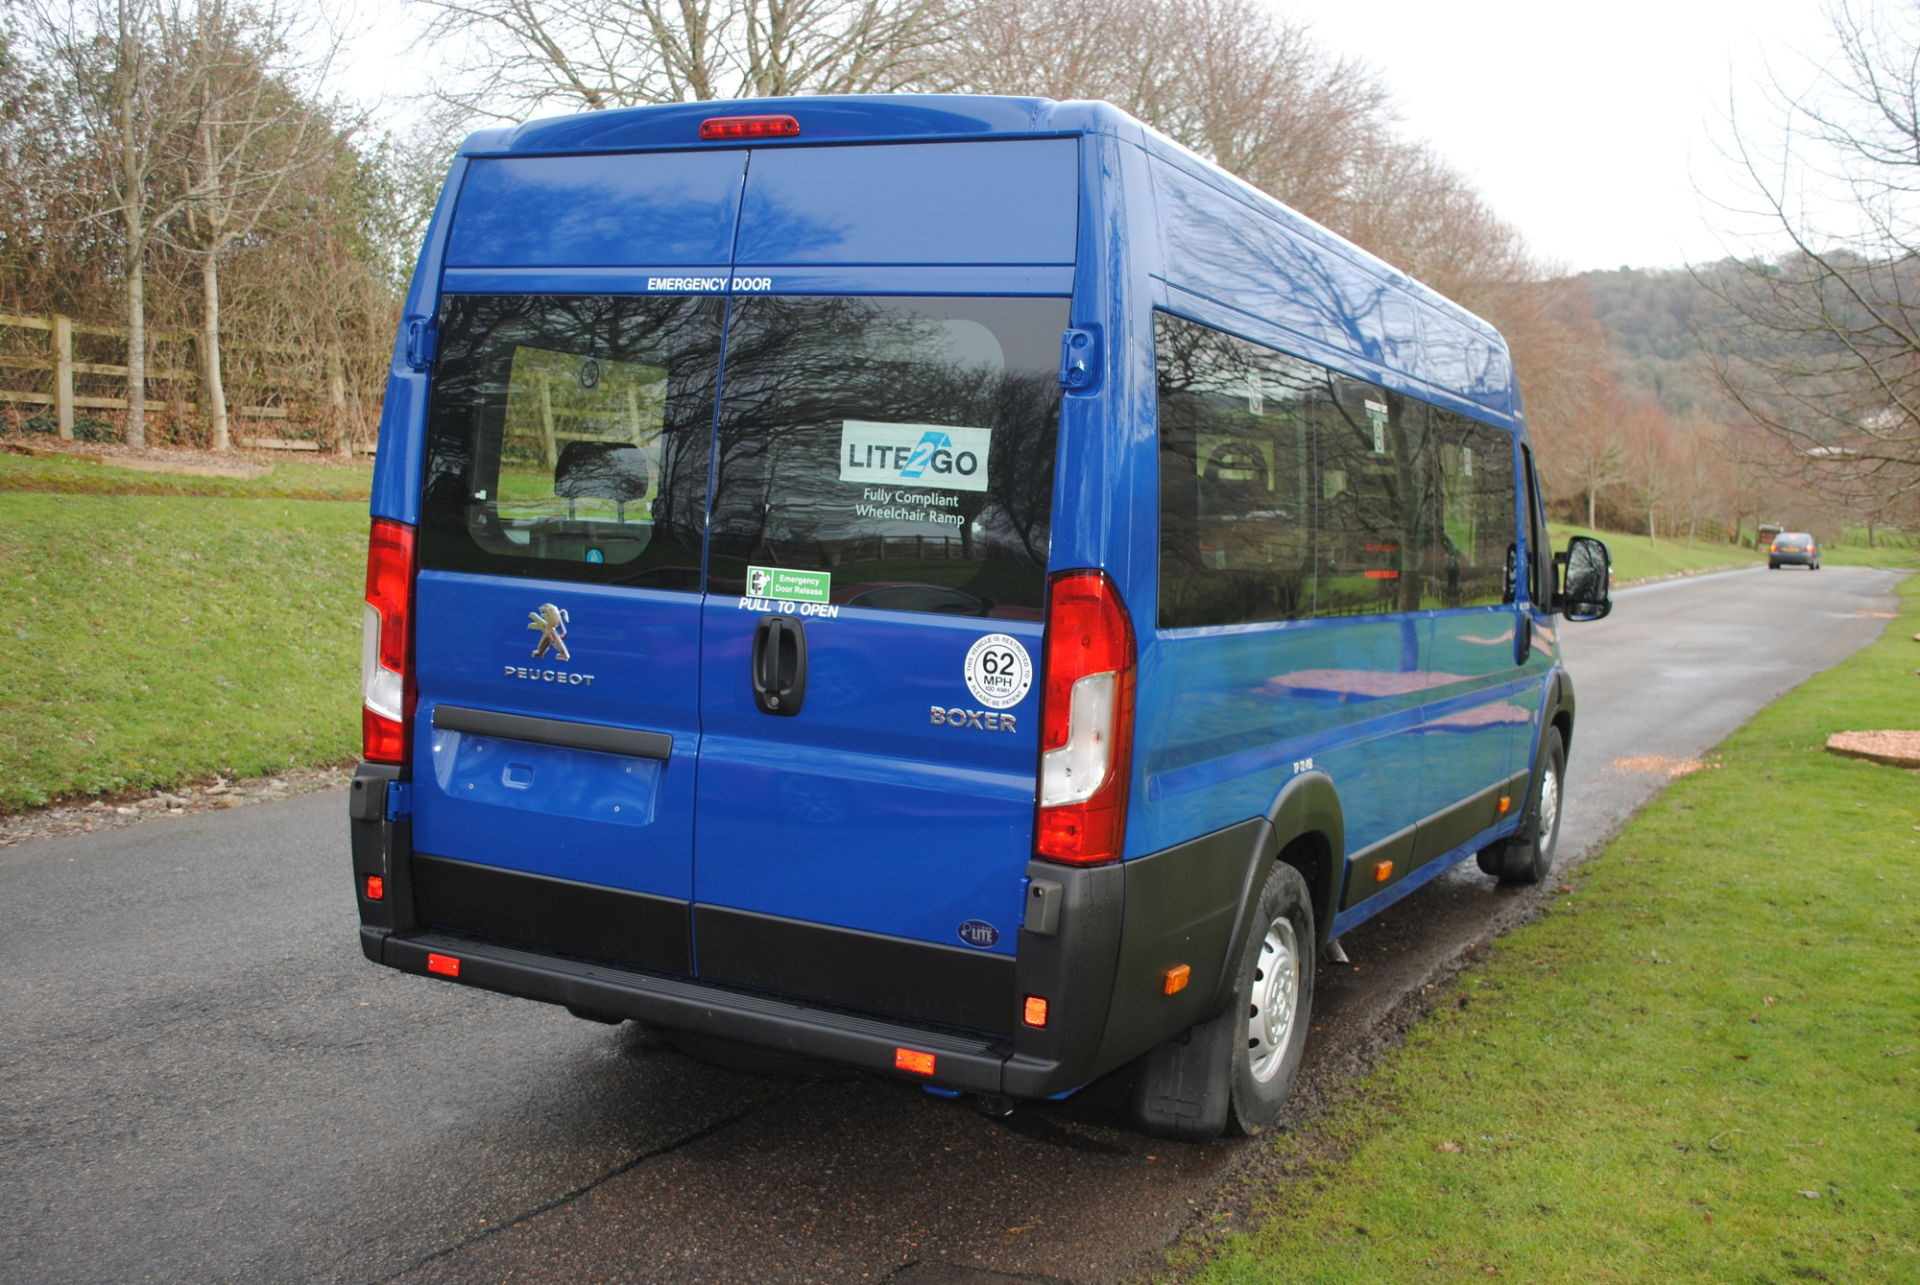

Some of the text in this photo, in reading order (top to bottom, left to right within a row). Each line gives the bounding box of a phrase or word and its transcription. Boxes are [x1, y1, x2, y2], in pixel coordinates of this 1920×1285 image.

[647, 277, 772, 291] EMERGENCY DOOR
[863, 488, 959, 508] Fully Compliant
[855, 504, 965, 529] Wheelchair Ramp
[775, 584, 823, 596] Door Release
[779, 574, 820, 586] Emergency
[738, 597, 839, 618] PULL TO OPEN
[982, 650, 1015, 676] 62
[504, 665, 595, 686] PEUGEOT
[983, 675, 1013, 688] MPH
[930, 705, 1016, 733] BOXER
[972, 927, 993, 942] LITE
